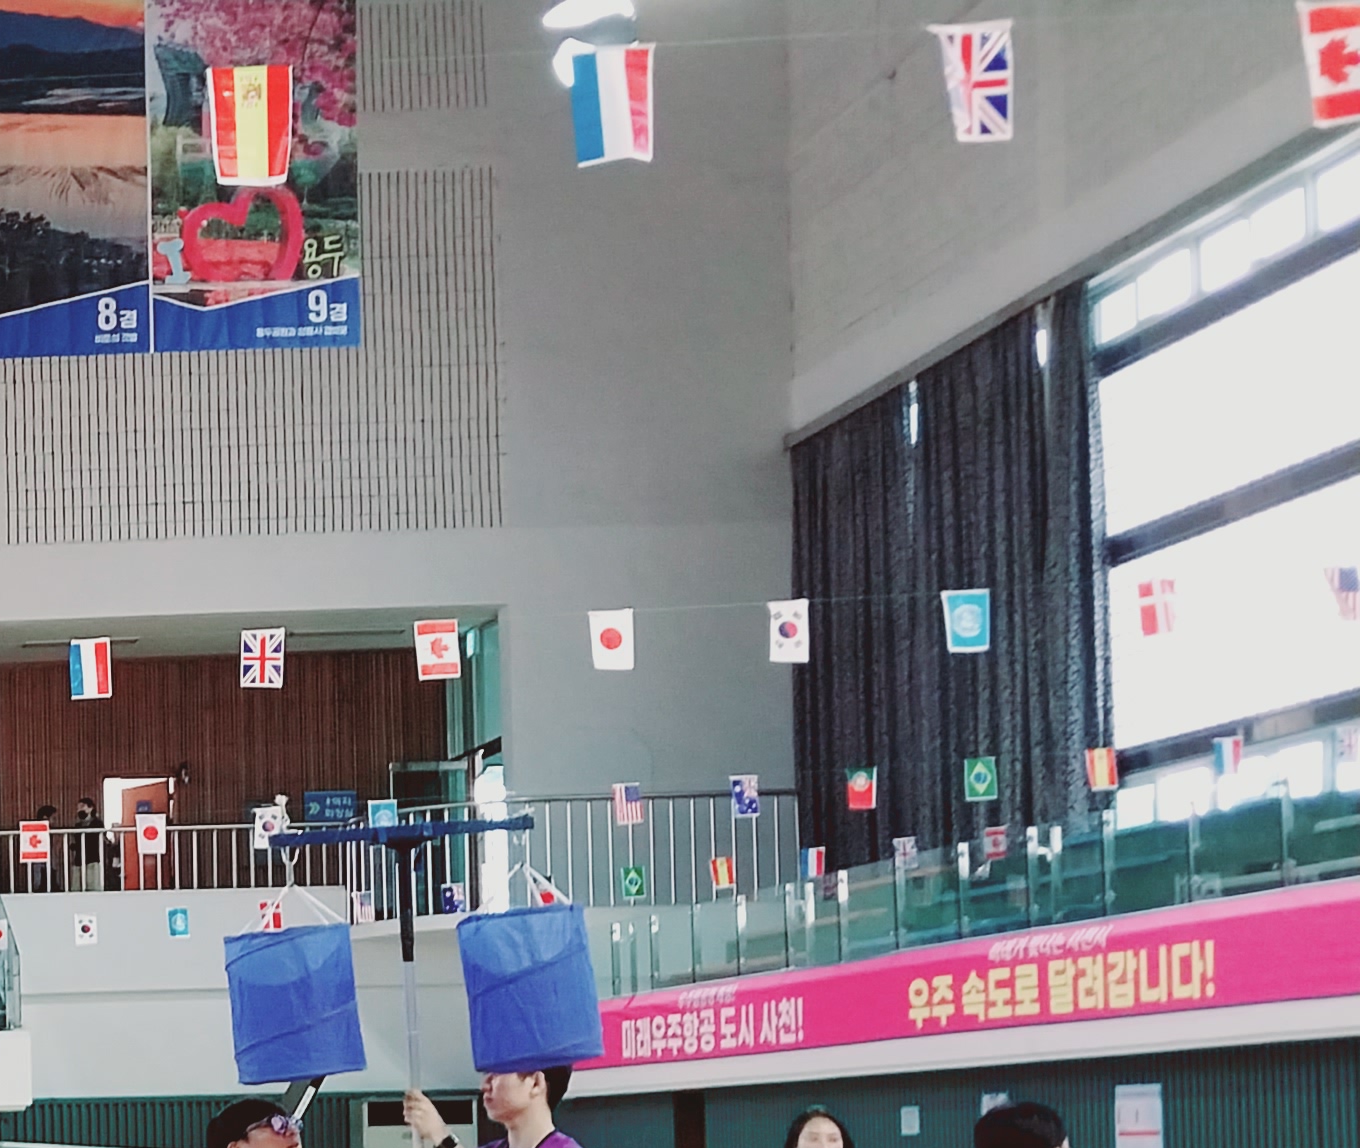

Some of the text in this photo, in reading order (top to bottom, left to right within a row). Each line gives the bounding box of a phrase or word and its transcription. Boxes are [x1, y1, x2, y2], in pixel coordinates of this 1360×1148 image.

[303, 234, 346, 279] 용두
[98, 297, 138, 331] 8경
[308, 289, 348, 323] 9경
[908, 939, 1217, 1030] 우주 속도로 달려갑니다!
[621, 996, 804, 1060] 미래우주항공 도시 사천!
